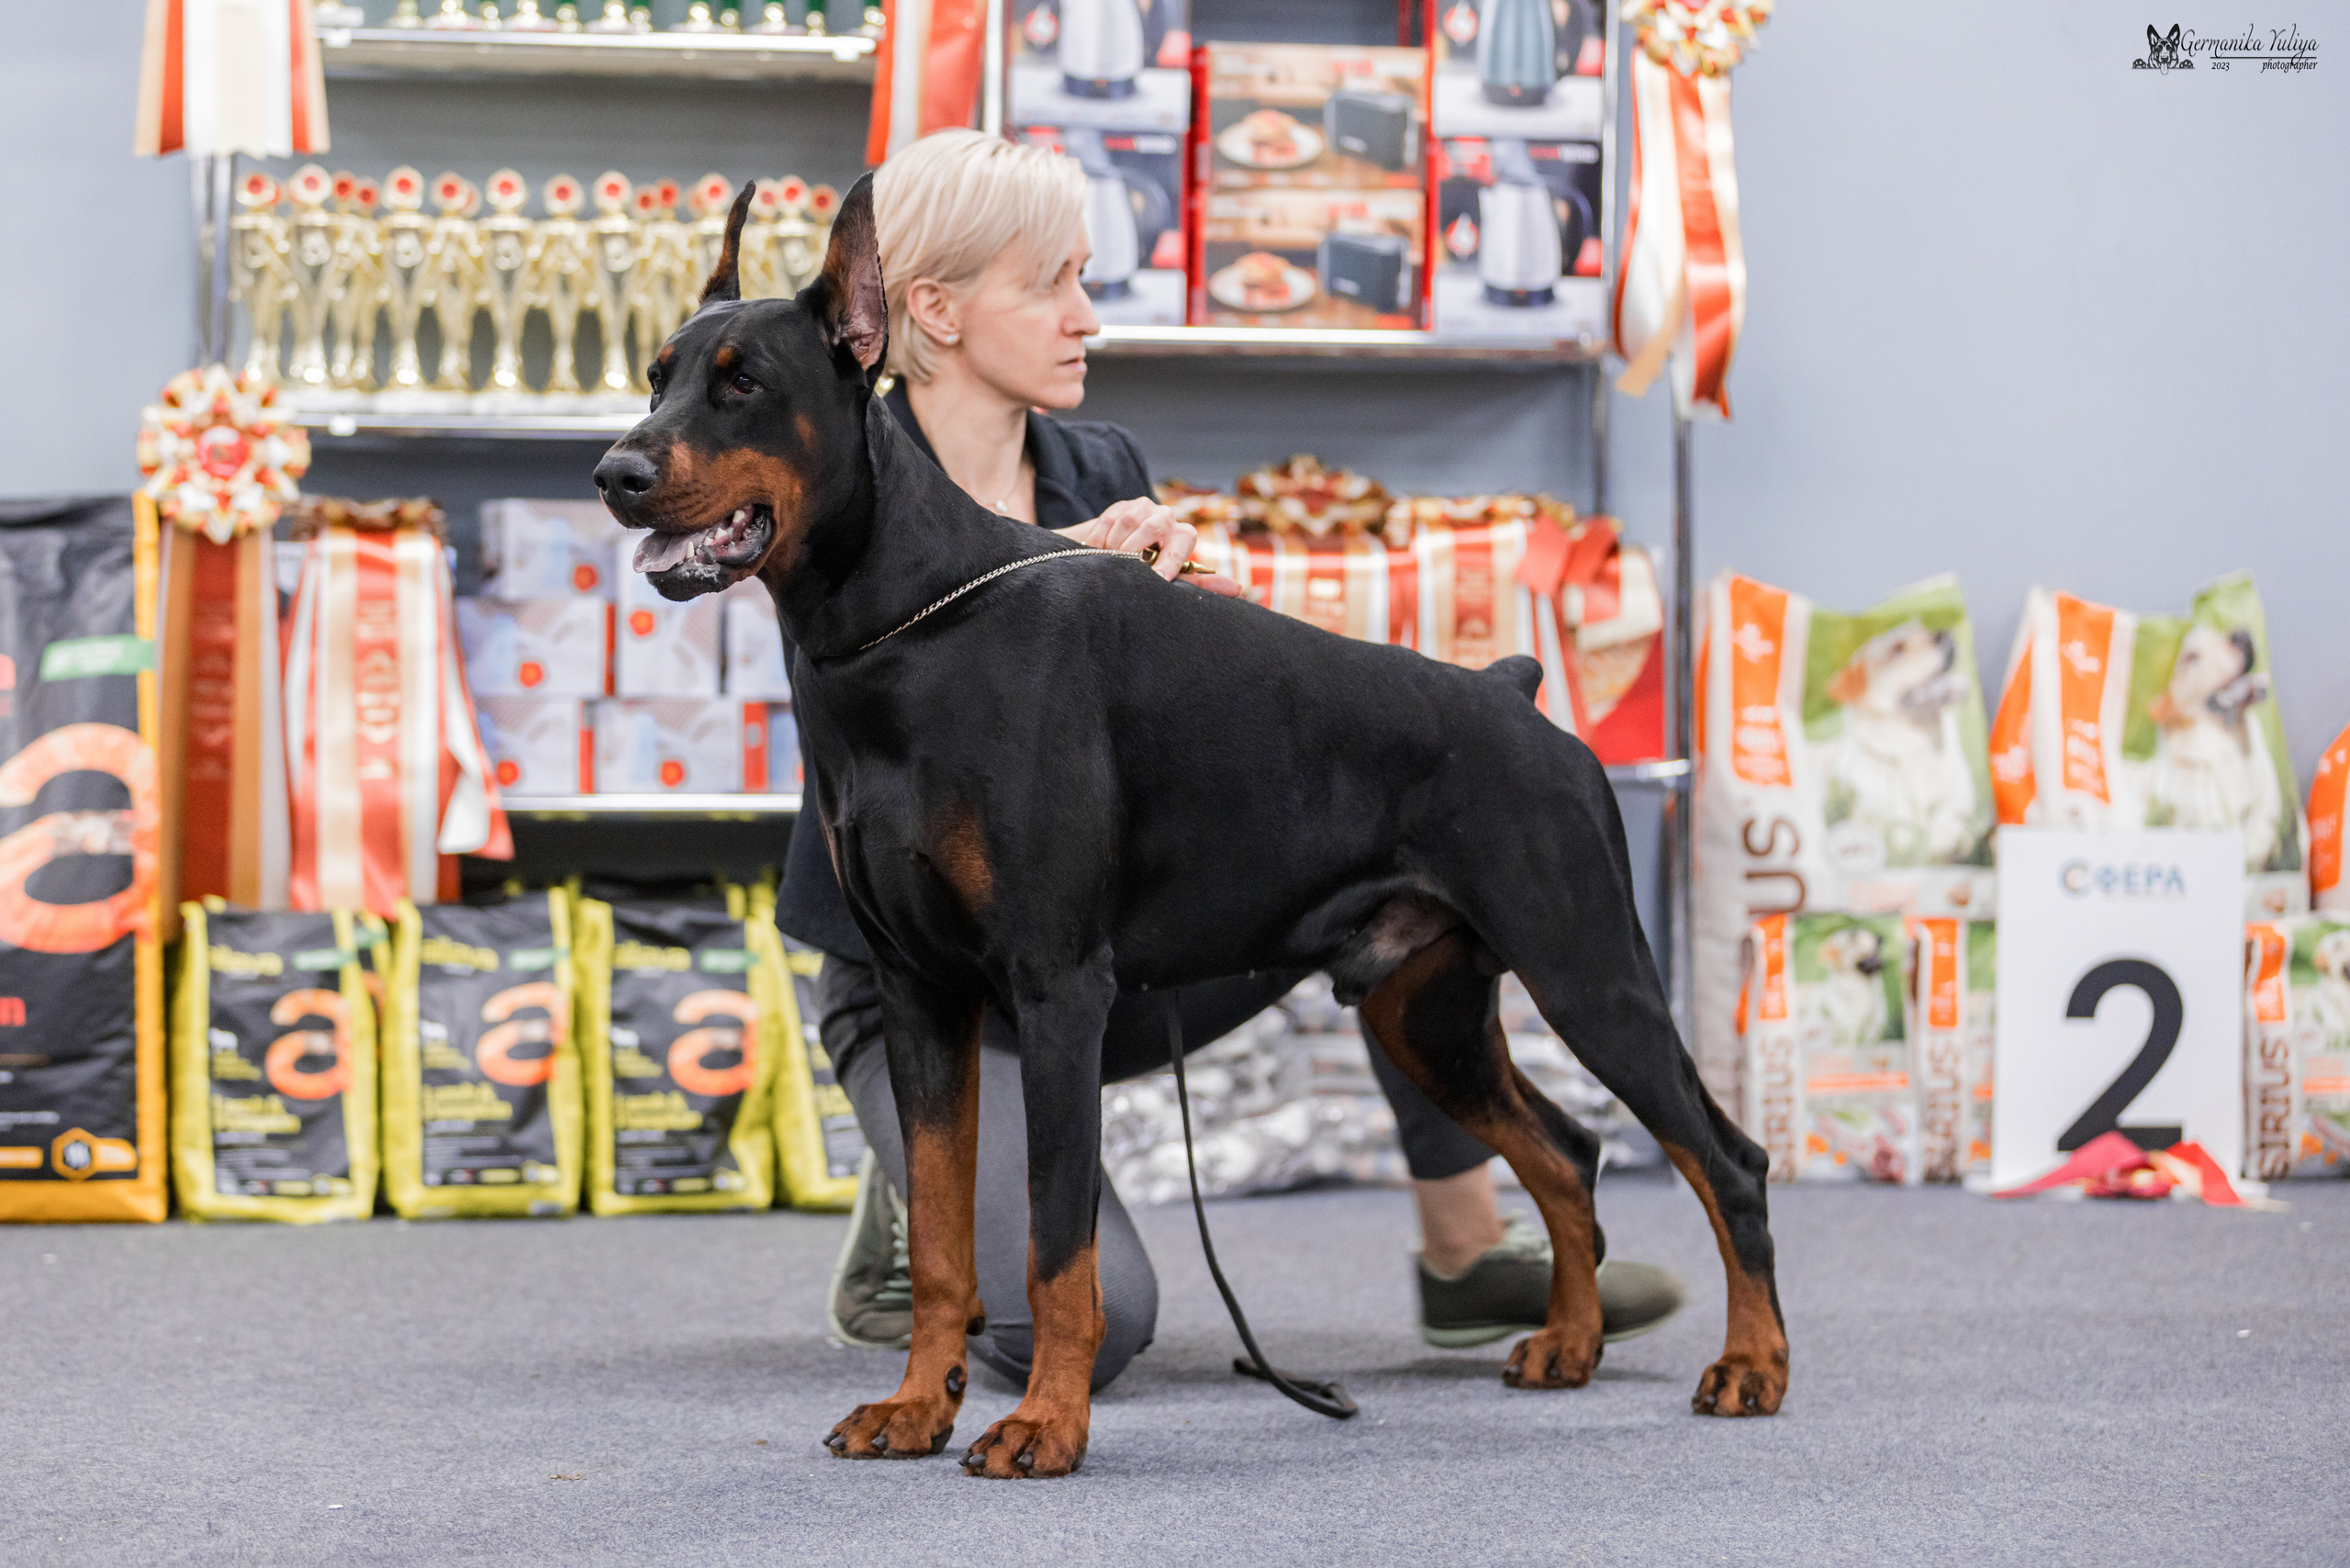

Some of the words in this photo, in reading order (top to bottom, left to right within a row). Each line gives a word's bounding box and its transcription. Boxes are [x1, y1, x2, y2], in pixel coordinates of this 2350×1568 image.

[2060, 858, 2186, 896] СФЕРА
[2057, 958, 2184, 1151] 2
[2260, 1036, 2292, 1181] SIRIUS
